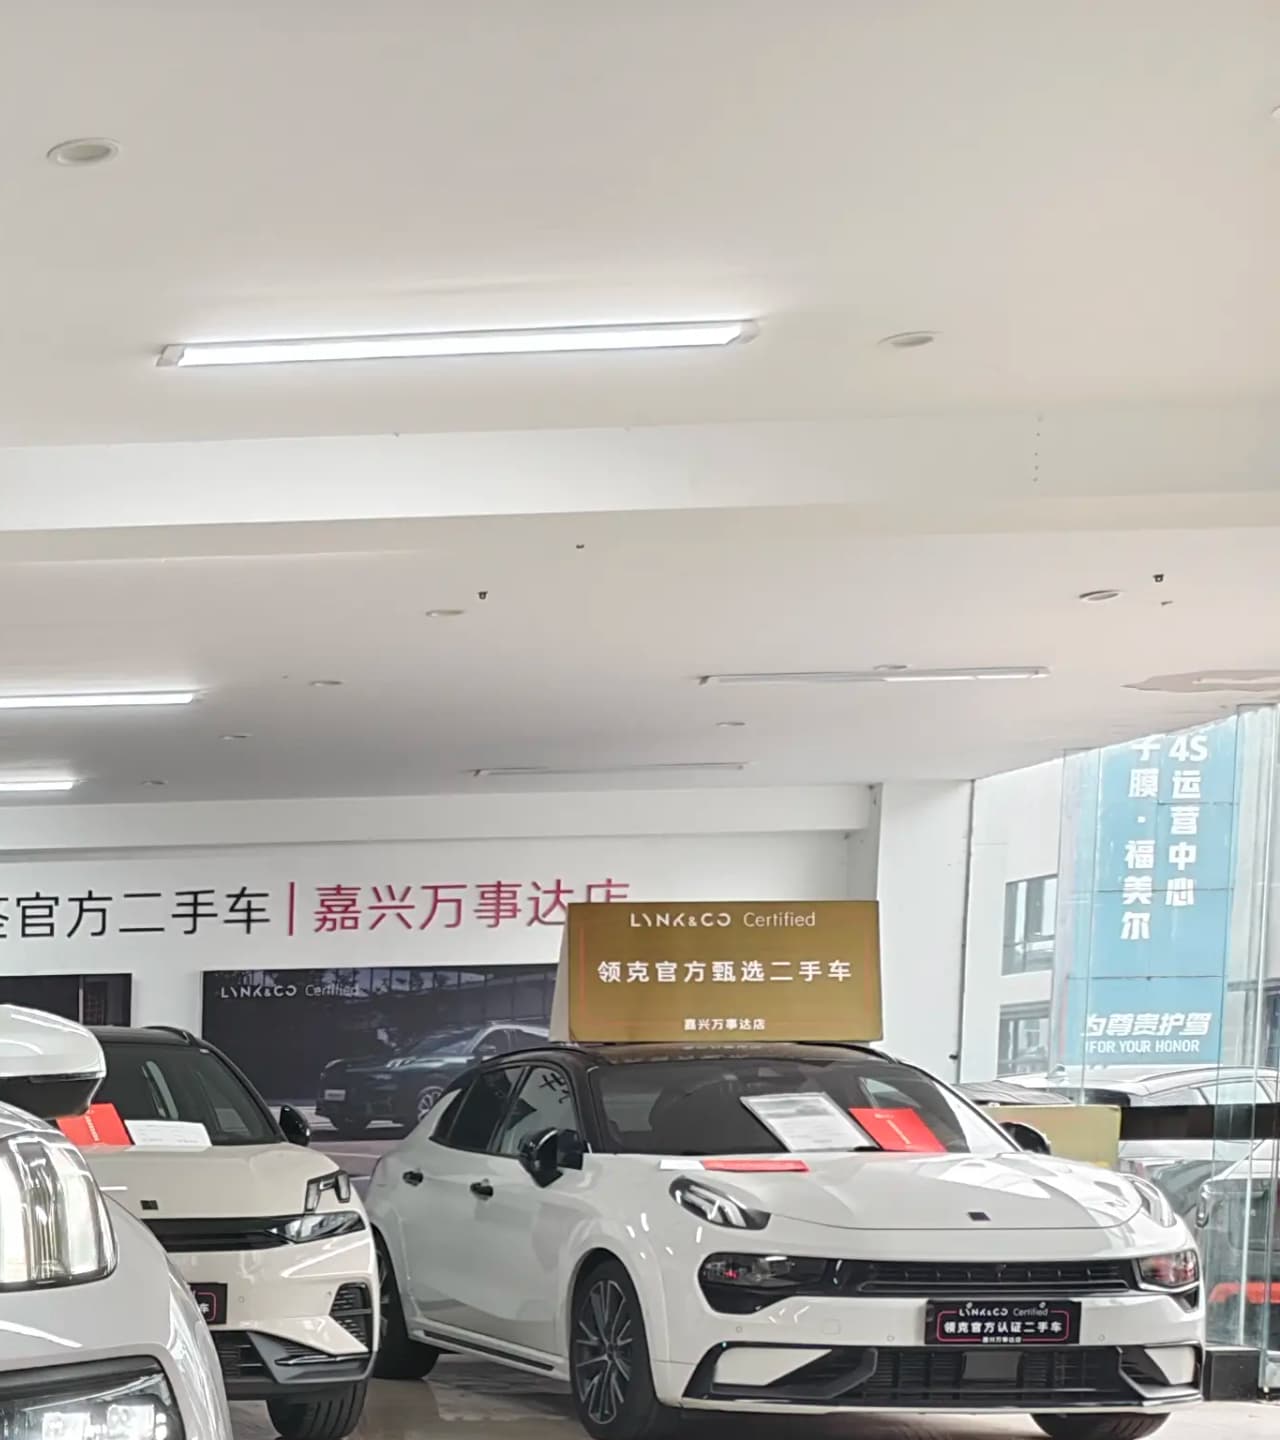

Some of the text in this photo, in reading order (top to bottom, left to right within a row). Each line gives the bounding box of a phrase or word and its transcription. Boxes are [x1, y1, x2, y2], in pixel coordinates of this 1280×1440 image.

[743, 911, 816, 928] Certified
[597, 960, 852, 983] 领克官方甄选二手车
[1089, 1039, 1200, 1053] FOR YOUR HONOR
[1013, 1307, 1048, 1317] Certified
[944, 1321, 1063, 1334] 领克官方认证二手车
